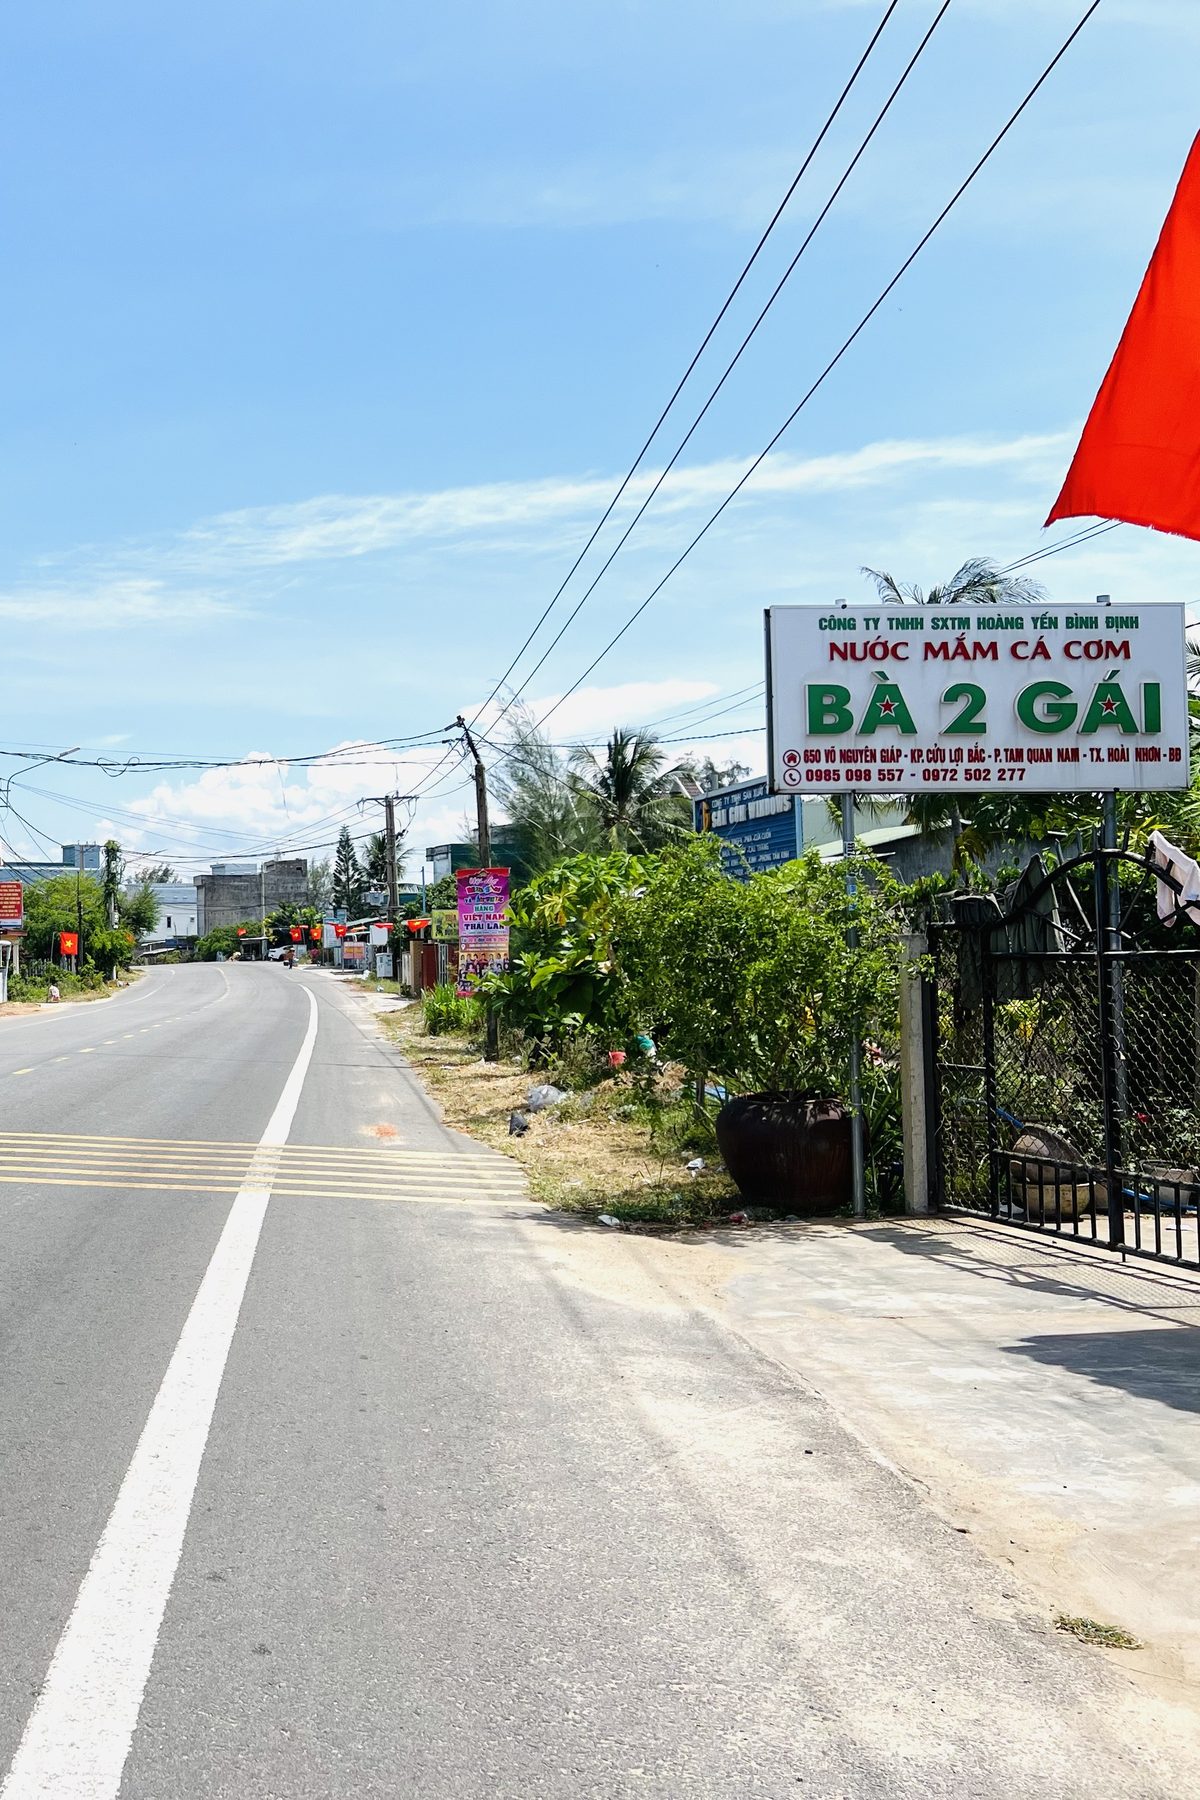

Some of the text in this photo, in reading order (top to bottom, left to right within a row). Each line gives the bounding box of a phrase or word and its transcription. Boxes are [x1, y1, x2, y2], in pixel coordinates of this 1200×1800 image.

[818, 612, 1139, 633] CÔNG TY TNHH SXTM HOÀNG YẾN BÌNH ĐỊNH
[829, 632, 1131, 661] NƯỚC MẮM CÁ CƠM
[805, 670, 1162, 735] BÀ 2 GÁI
[824, 746, 836, 763] VÕ
[839, 746, 876, 763] NGUYÊN
[880, 745, 902, 763] GIÁP
[949, 747, 964, 766] LỢI
[967, 742, 985, 763] BẮC
[1004, 748, 1024, 762] TAM
[1027, 748, 1052, 764] QUAN
[1057, 748, 1080, 762] NAM
[1089, 748, 1104, 762] TX.
[1107, 744, 1130, 762] HOÀI
[1135, 746, 1161, 762] NHƠN
[805, 768, 841, 781] 0985
[845, 768, 871, 781] 098
[878, 769, 904, 781] 557
[922, 768, 958, 781] 0972
[964, 768, 991, 781] 502
[997, 768, 1026, 781] 277
[485, 913, 505, 921] NAM
